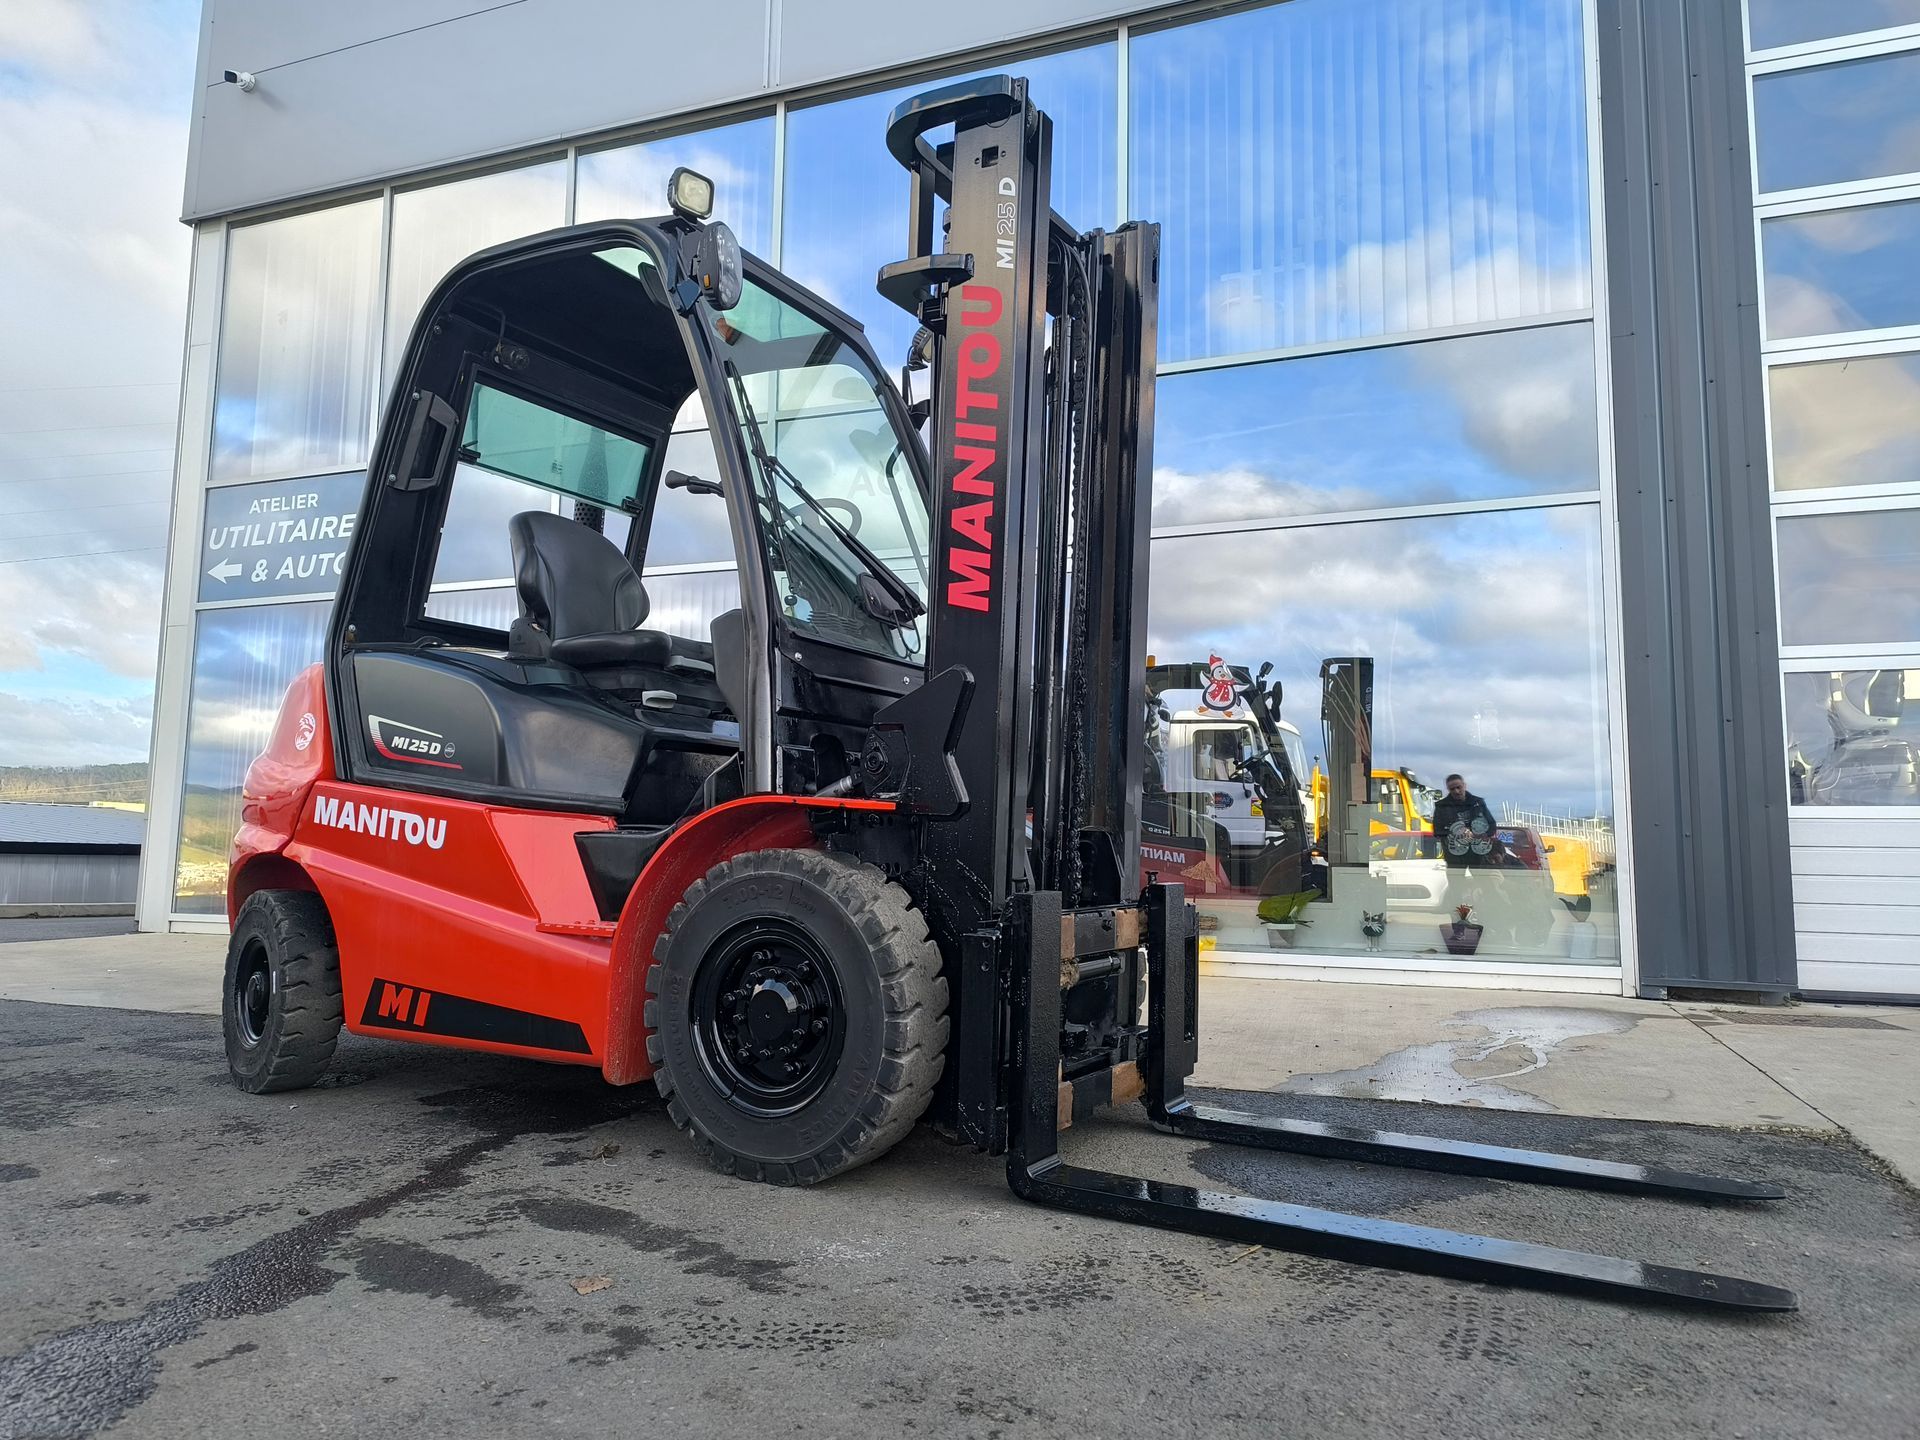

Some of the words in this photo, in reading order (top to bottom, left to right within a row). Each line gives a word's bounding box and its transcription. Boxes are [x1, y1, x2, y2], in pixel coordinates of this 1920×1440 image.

[947, 285, 1003, 612] MANITOU
[249, 493, 319, 515] ATELIER
[209, 513, 357, 550] UTILITAIRE
[250, 559, 268, 583] &
[313, 795, 447, 850] MANITOU
[378, 982, 431, 1027] MI
